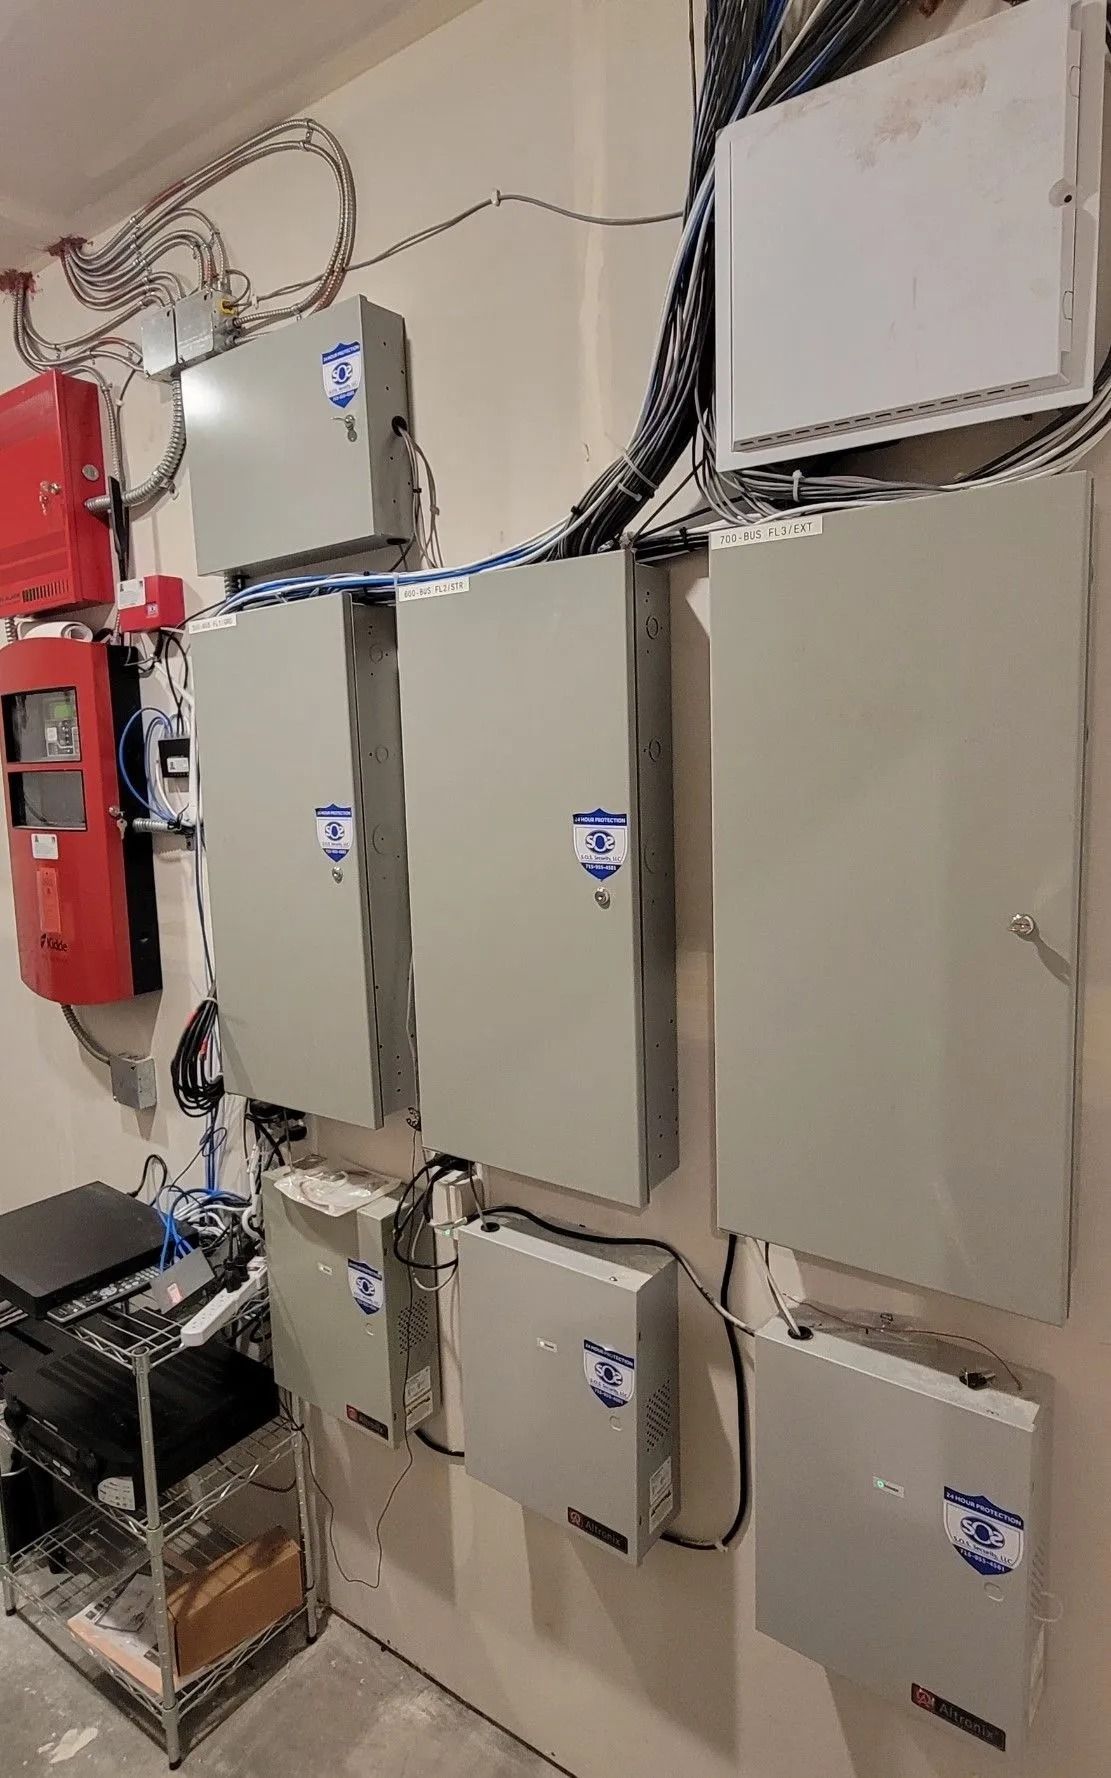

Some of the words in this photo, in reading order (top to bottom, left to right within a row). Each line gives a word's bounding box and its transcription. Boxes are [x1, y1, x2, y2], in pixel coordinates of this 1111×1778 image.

[720, 530, 762, 544] 700-BUS
[768, 522, 813, 537] FL3/EXT
[435, 582, 464, 594] FL2/STR
[946, 1491, 954, 1500] 24
[955, 1495, 975, 1508] HOUR
[976, 1503, 1022, 1526] PROTECTION
[939, 1703, 994, 1738] Altronix
